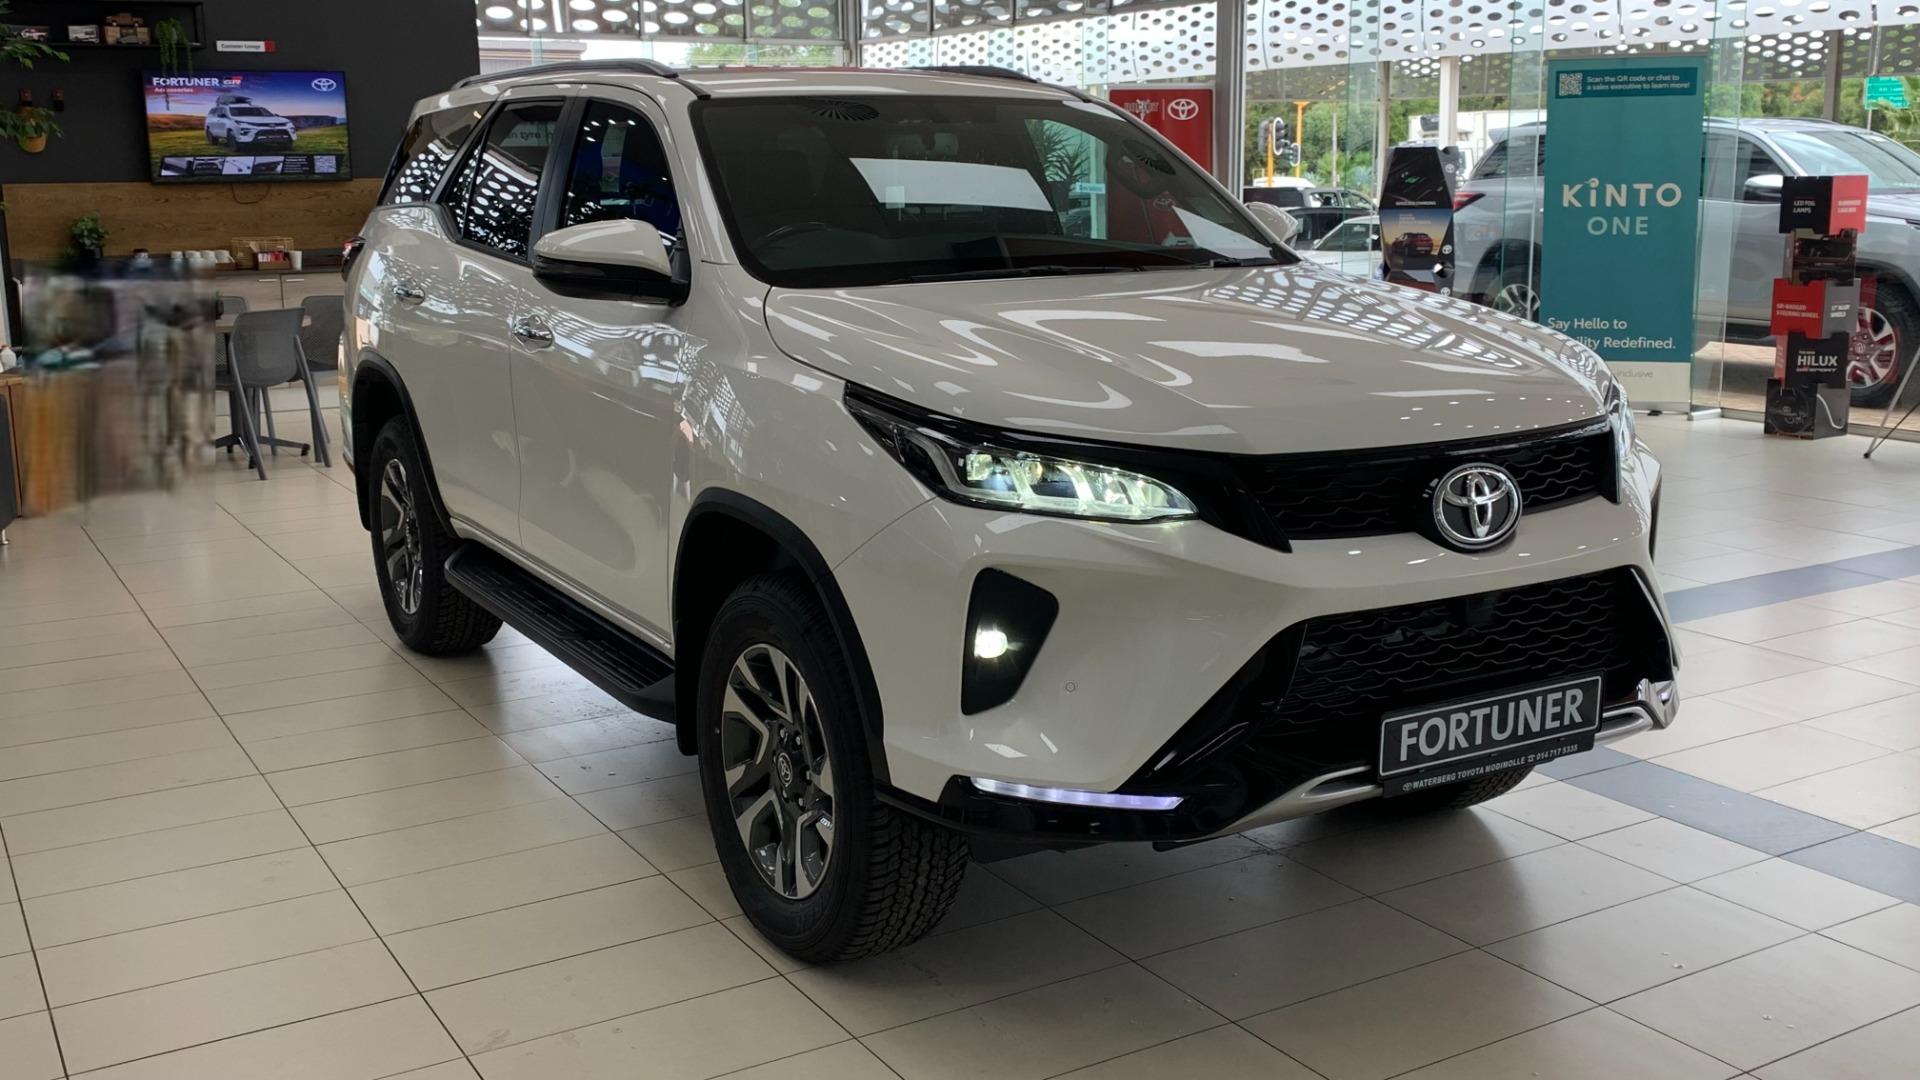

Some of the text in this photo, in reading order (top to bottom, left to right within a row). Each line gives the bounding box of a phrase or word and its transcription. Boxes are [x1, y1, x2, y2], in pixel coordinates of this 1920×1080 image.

[153, 77, 220, 87] FORTUNER
[1587, 216, 1649, 235] ONE
[1547, 317, 1628, 331] Say Hello to
[1603, 336, 1676, 349] Redefined.
[1797, 355, 1838, 367] HILUX
[1400, 688, 1584, 762] FORTUNER
[1413, 773, 1456, 788] WATERBERG
[1458, 767, 1484, 779] TOYOTA
[1485, 758, 1525, 773] MODIMOLLE
[1536, 752, 1549, 761] 014
